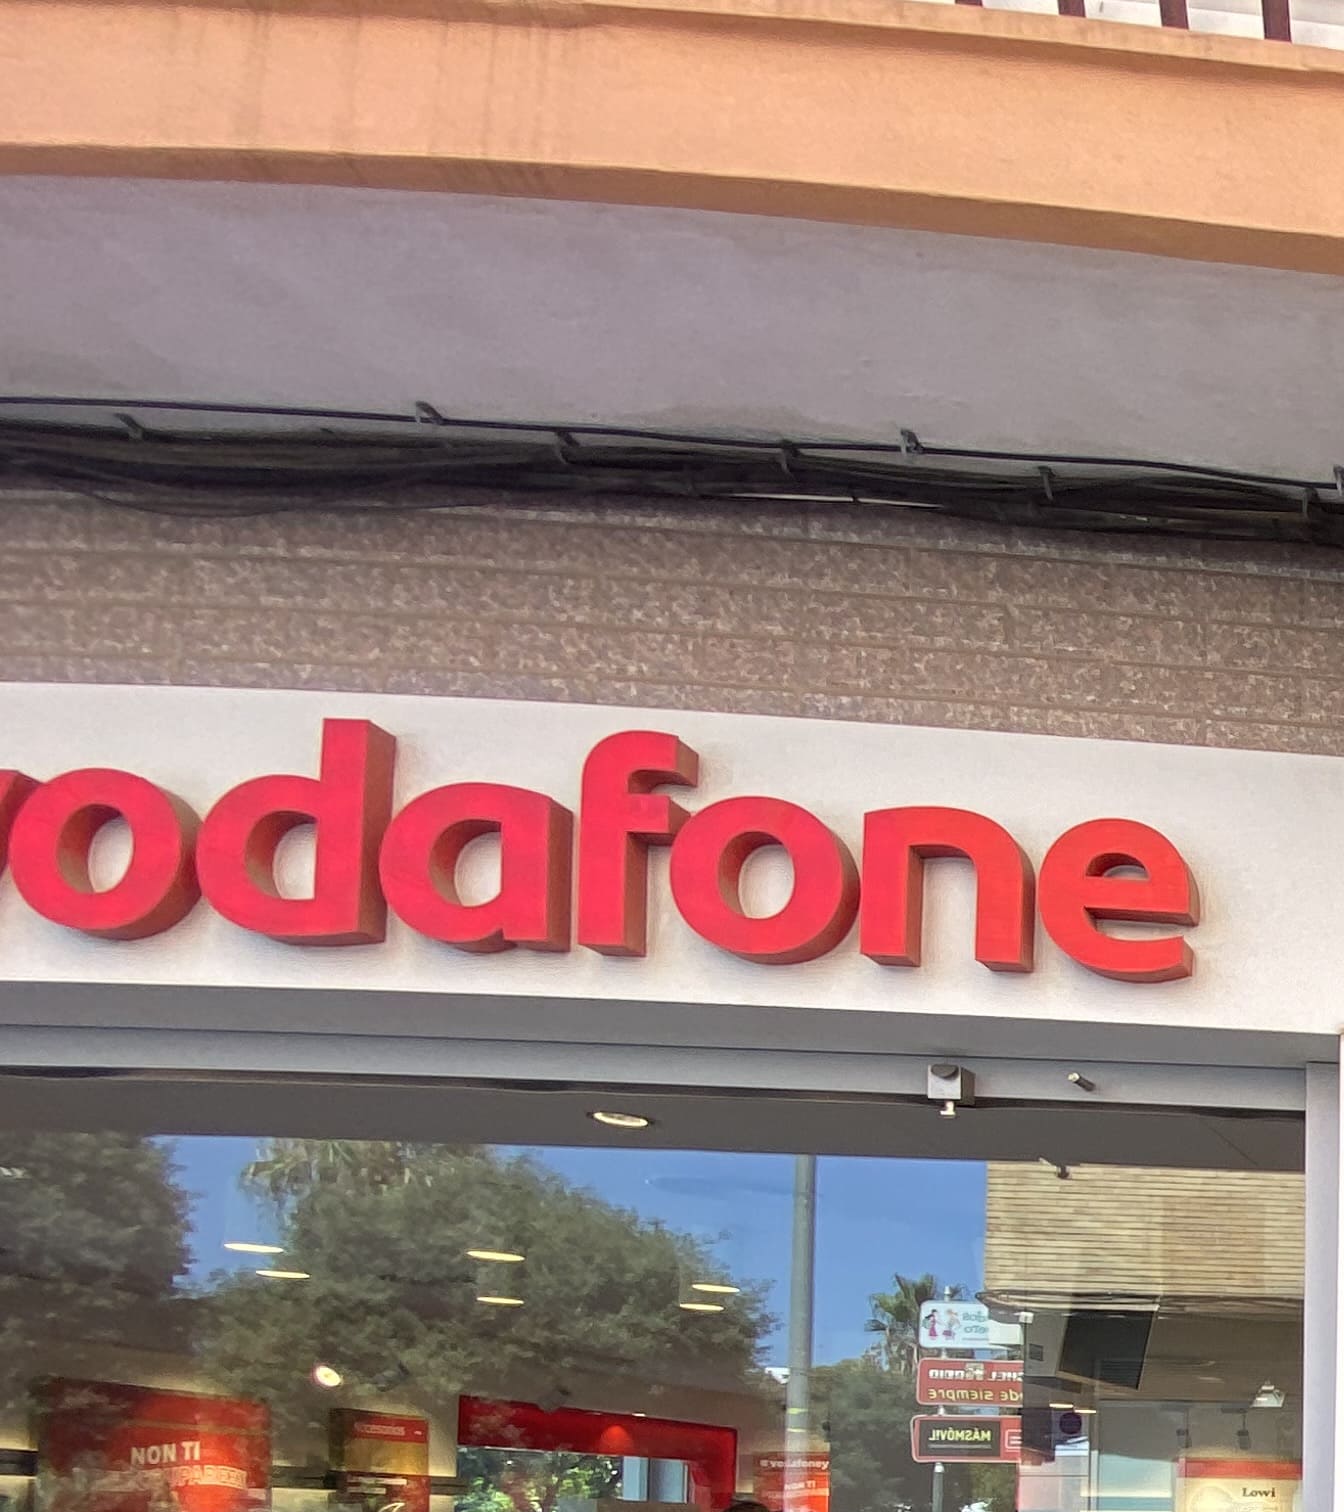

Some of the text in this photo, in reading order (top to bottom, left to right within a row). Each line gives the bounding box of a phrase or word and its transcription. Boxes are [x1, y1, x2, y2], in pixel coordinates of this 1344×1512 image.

[131, 1441, 201, 1464] NON TI
[1241, 1487, 1277, 1498] Lowi
